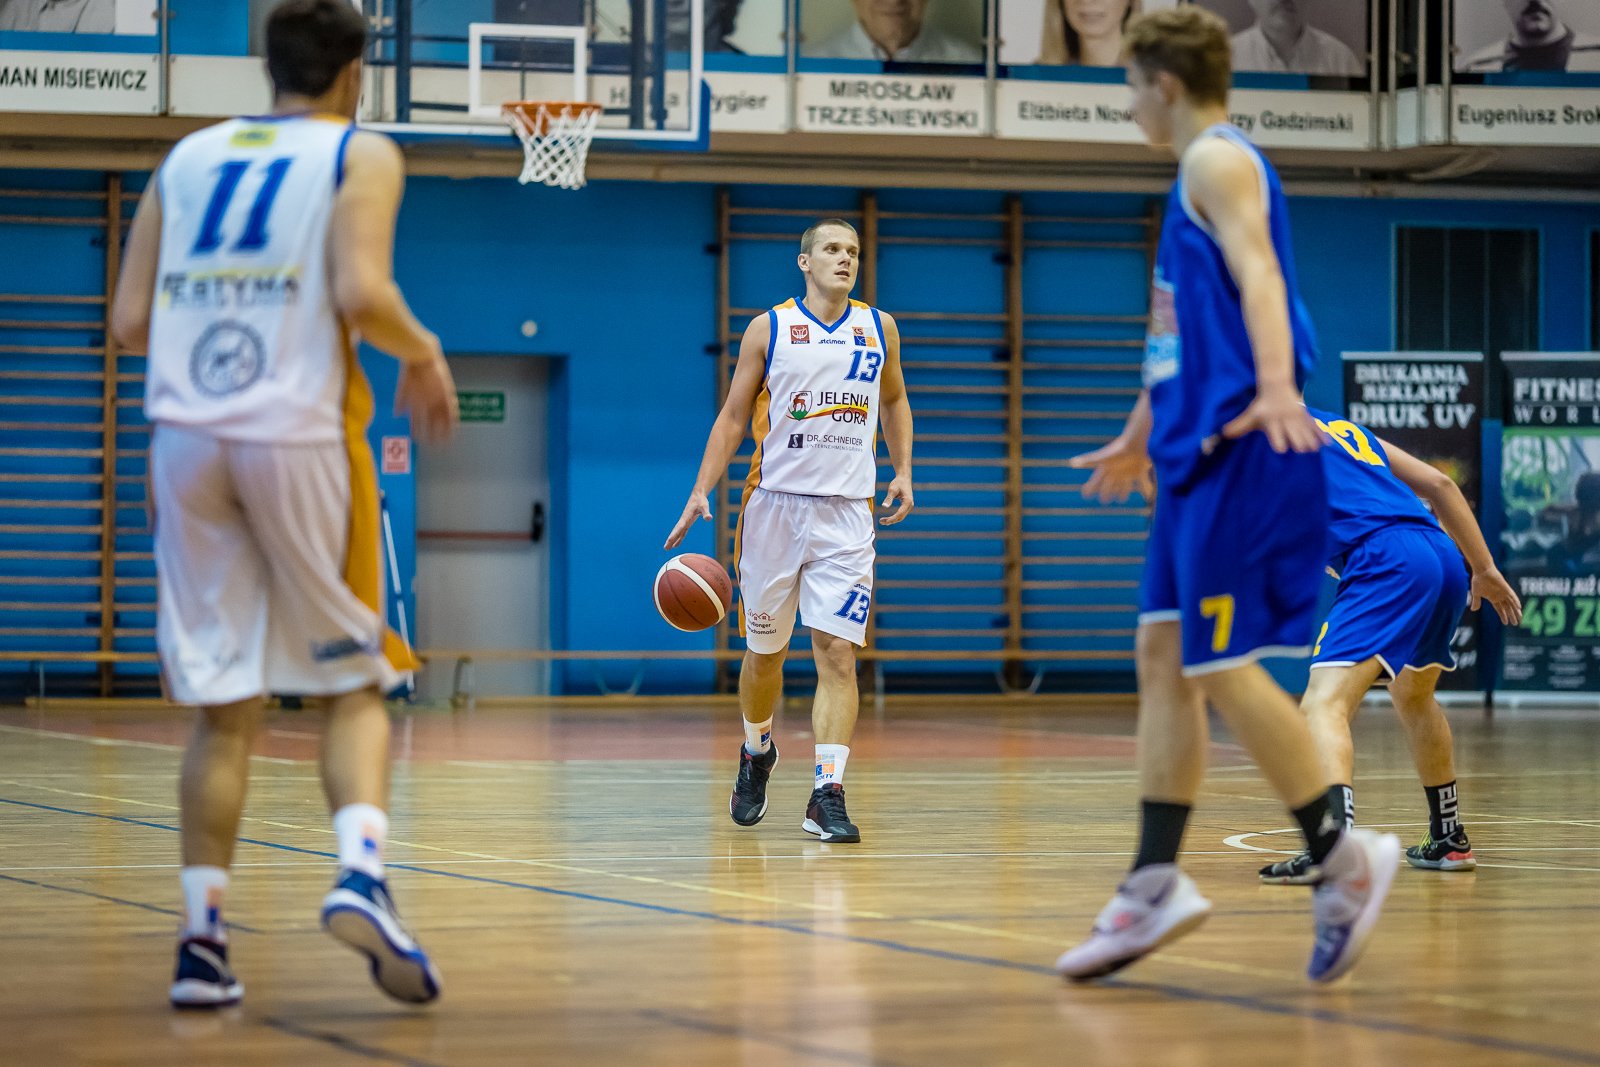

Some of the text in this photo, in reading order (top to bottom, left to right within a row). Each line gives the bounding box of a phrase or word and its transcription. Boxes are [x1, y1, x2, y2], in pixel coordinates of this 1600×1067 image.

[44, 67, 148, 91] MISIEWICZ
[829, 80, 955, 101] MIROSŁAW
[806, 101, 979, 129] TRZEŚNIEWSKI
[1457, 103, 1556, 129] Eugeniusz
[190, 157, 296, 256] 11
[844, 350, 882, 383] 13
[1354, 363, 1470, 385] DRUKARNIA
[817, 391, 869, 409] JELENIA
[1361, 382, 1461, 403] REKLAMY
[832, 407, 867, 426] GÓRA
[1348, 402, 1477, 429] DRUK UV
[806, 434, 863, 446] DR. SCHNEIDER
[834, 589, 870, 625] 13
[1520, 597, 1567, 637] 49
[1199, 594, 1235, 653] 7
